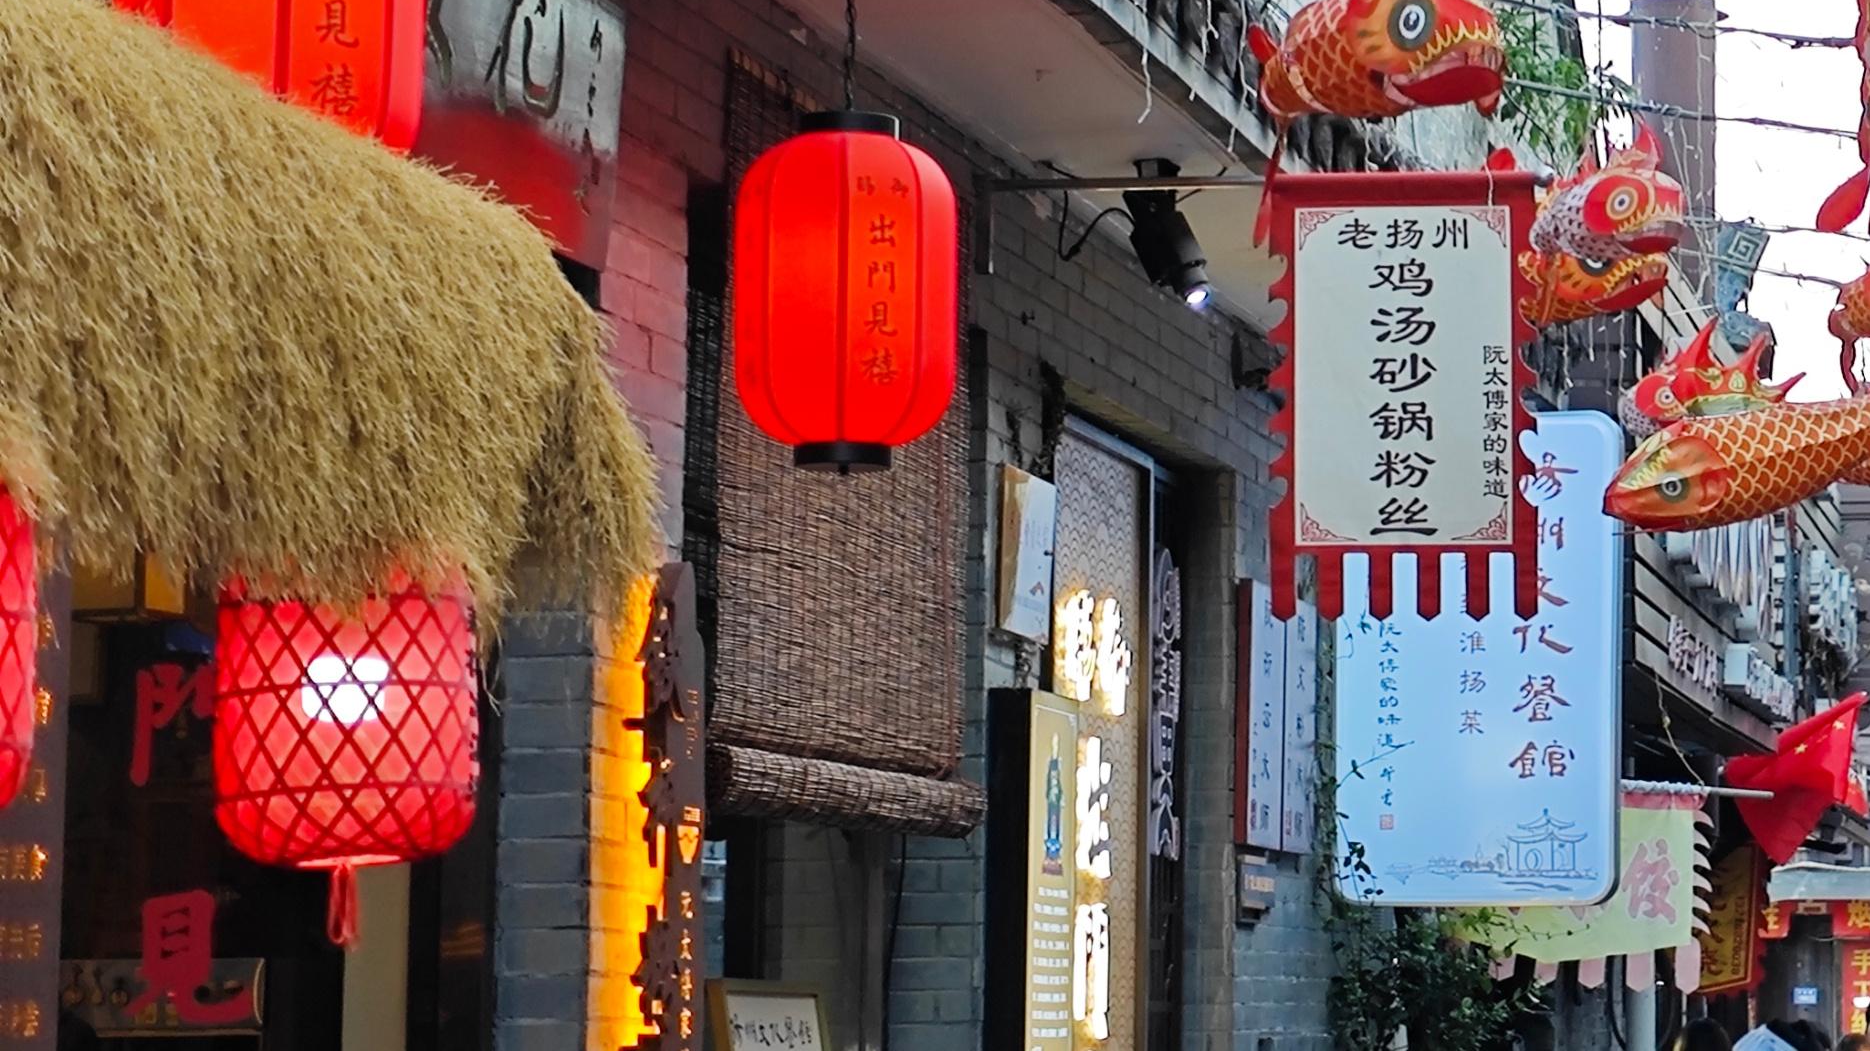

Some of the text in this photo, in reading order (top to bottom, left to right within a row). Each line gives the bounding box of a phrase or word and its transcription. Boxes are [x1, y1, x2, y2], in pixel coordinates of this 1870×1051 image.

[1336, 216, 1470, 251] 老扬州
[1367, 257, 1439, 538] 鸡汤砂锅粉丝
[1482, 344, 1509, 499] 阮太傅家的味道
